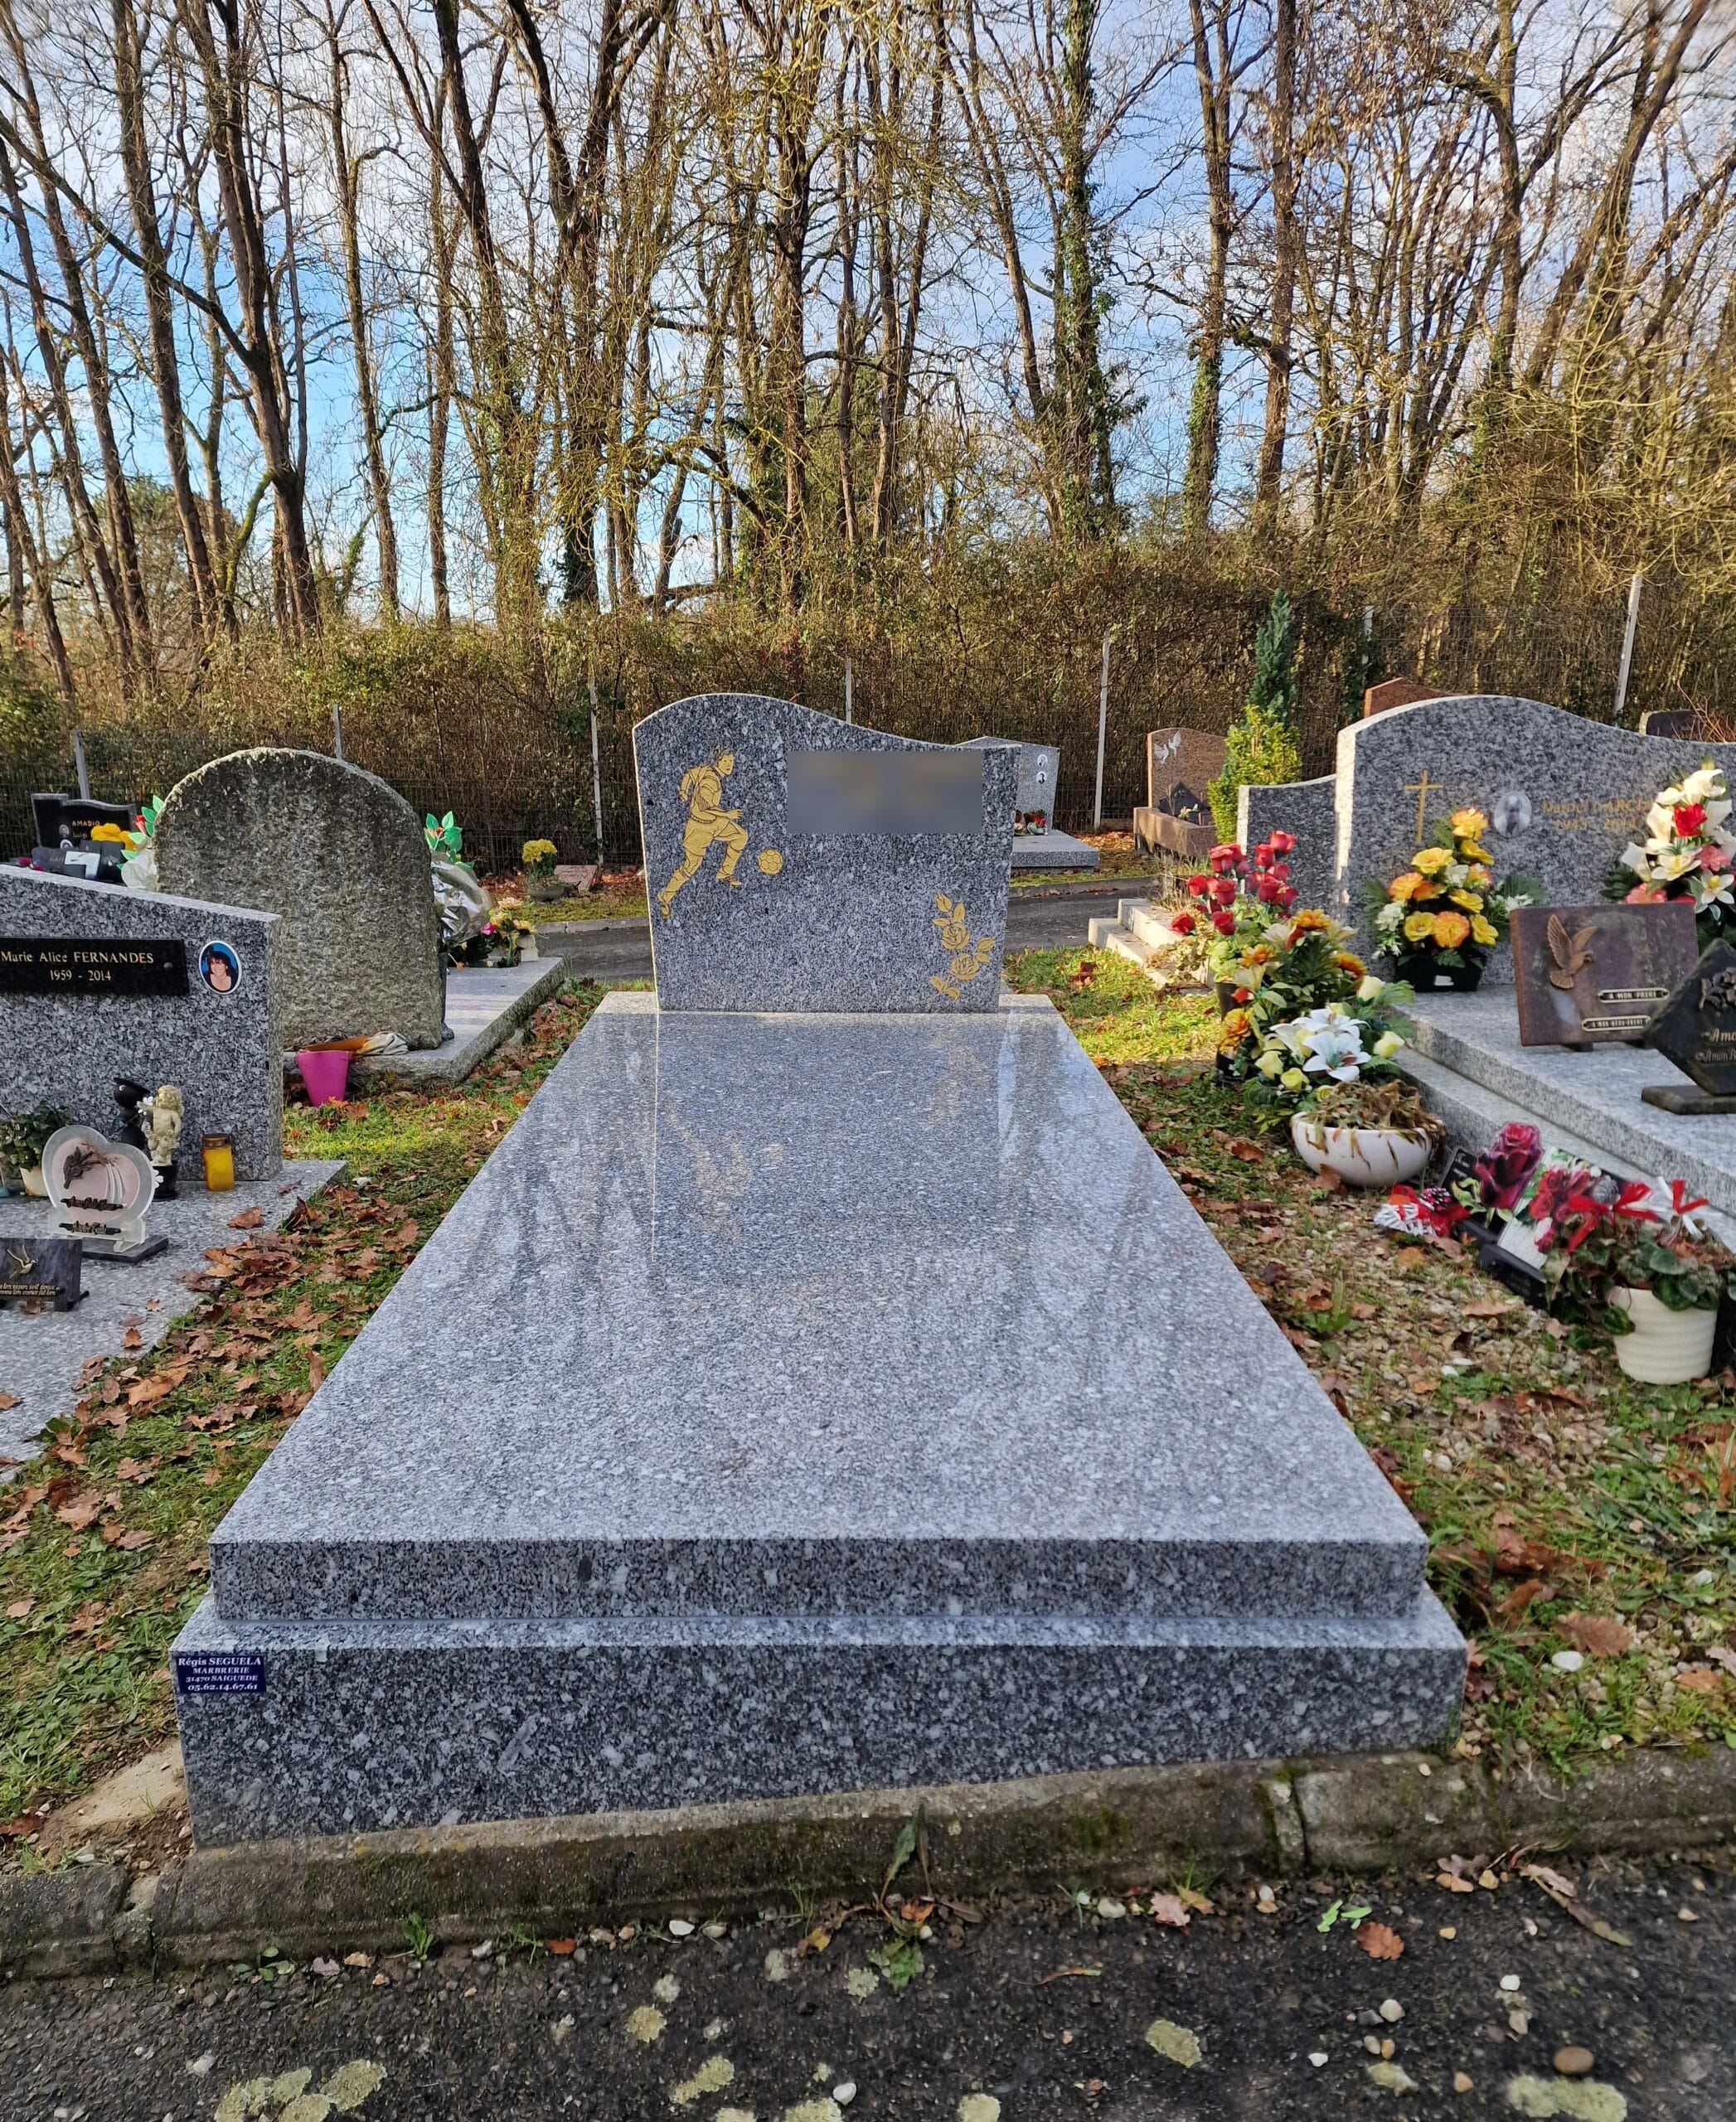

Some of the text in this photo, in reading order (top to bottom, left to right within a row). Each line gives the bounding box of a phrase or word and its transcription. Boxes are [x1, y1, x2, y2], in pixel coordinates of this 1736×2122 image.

[1, 951, 154, 964] Marie Alice FERNANDES
[50, 969, 72, 981] 1959
[89, 970, 112, 981] 2014
[178, 1657, 261, 1668] Régis SEGUELA
[187, 1683, 258, 1692] 05.62.14.67.61
